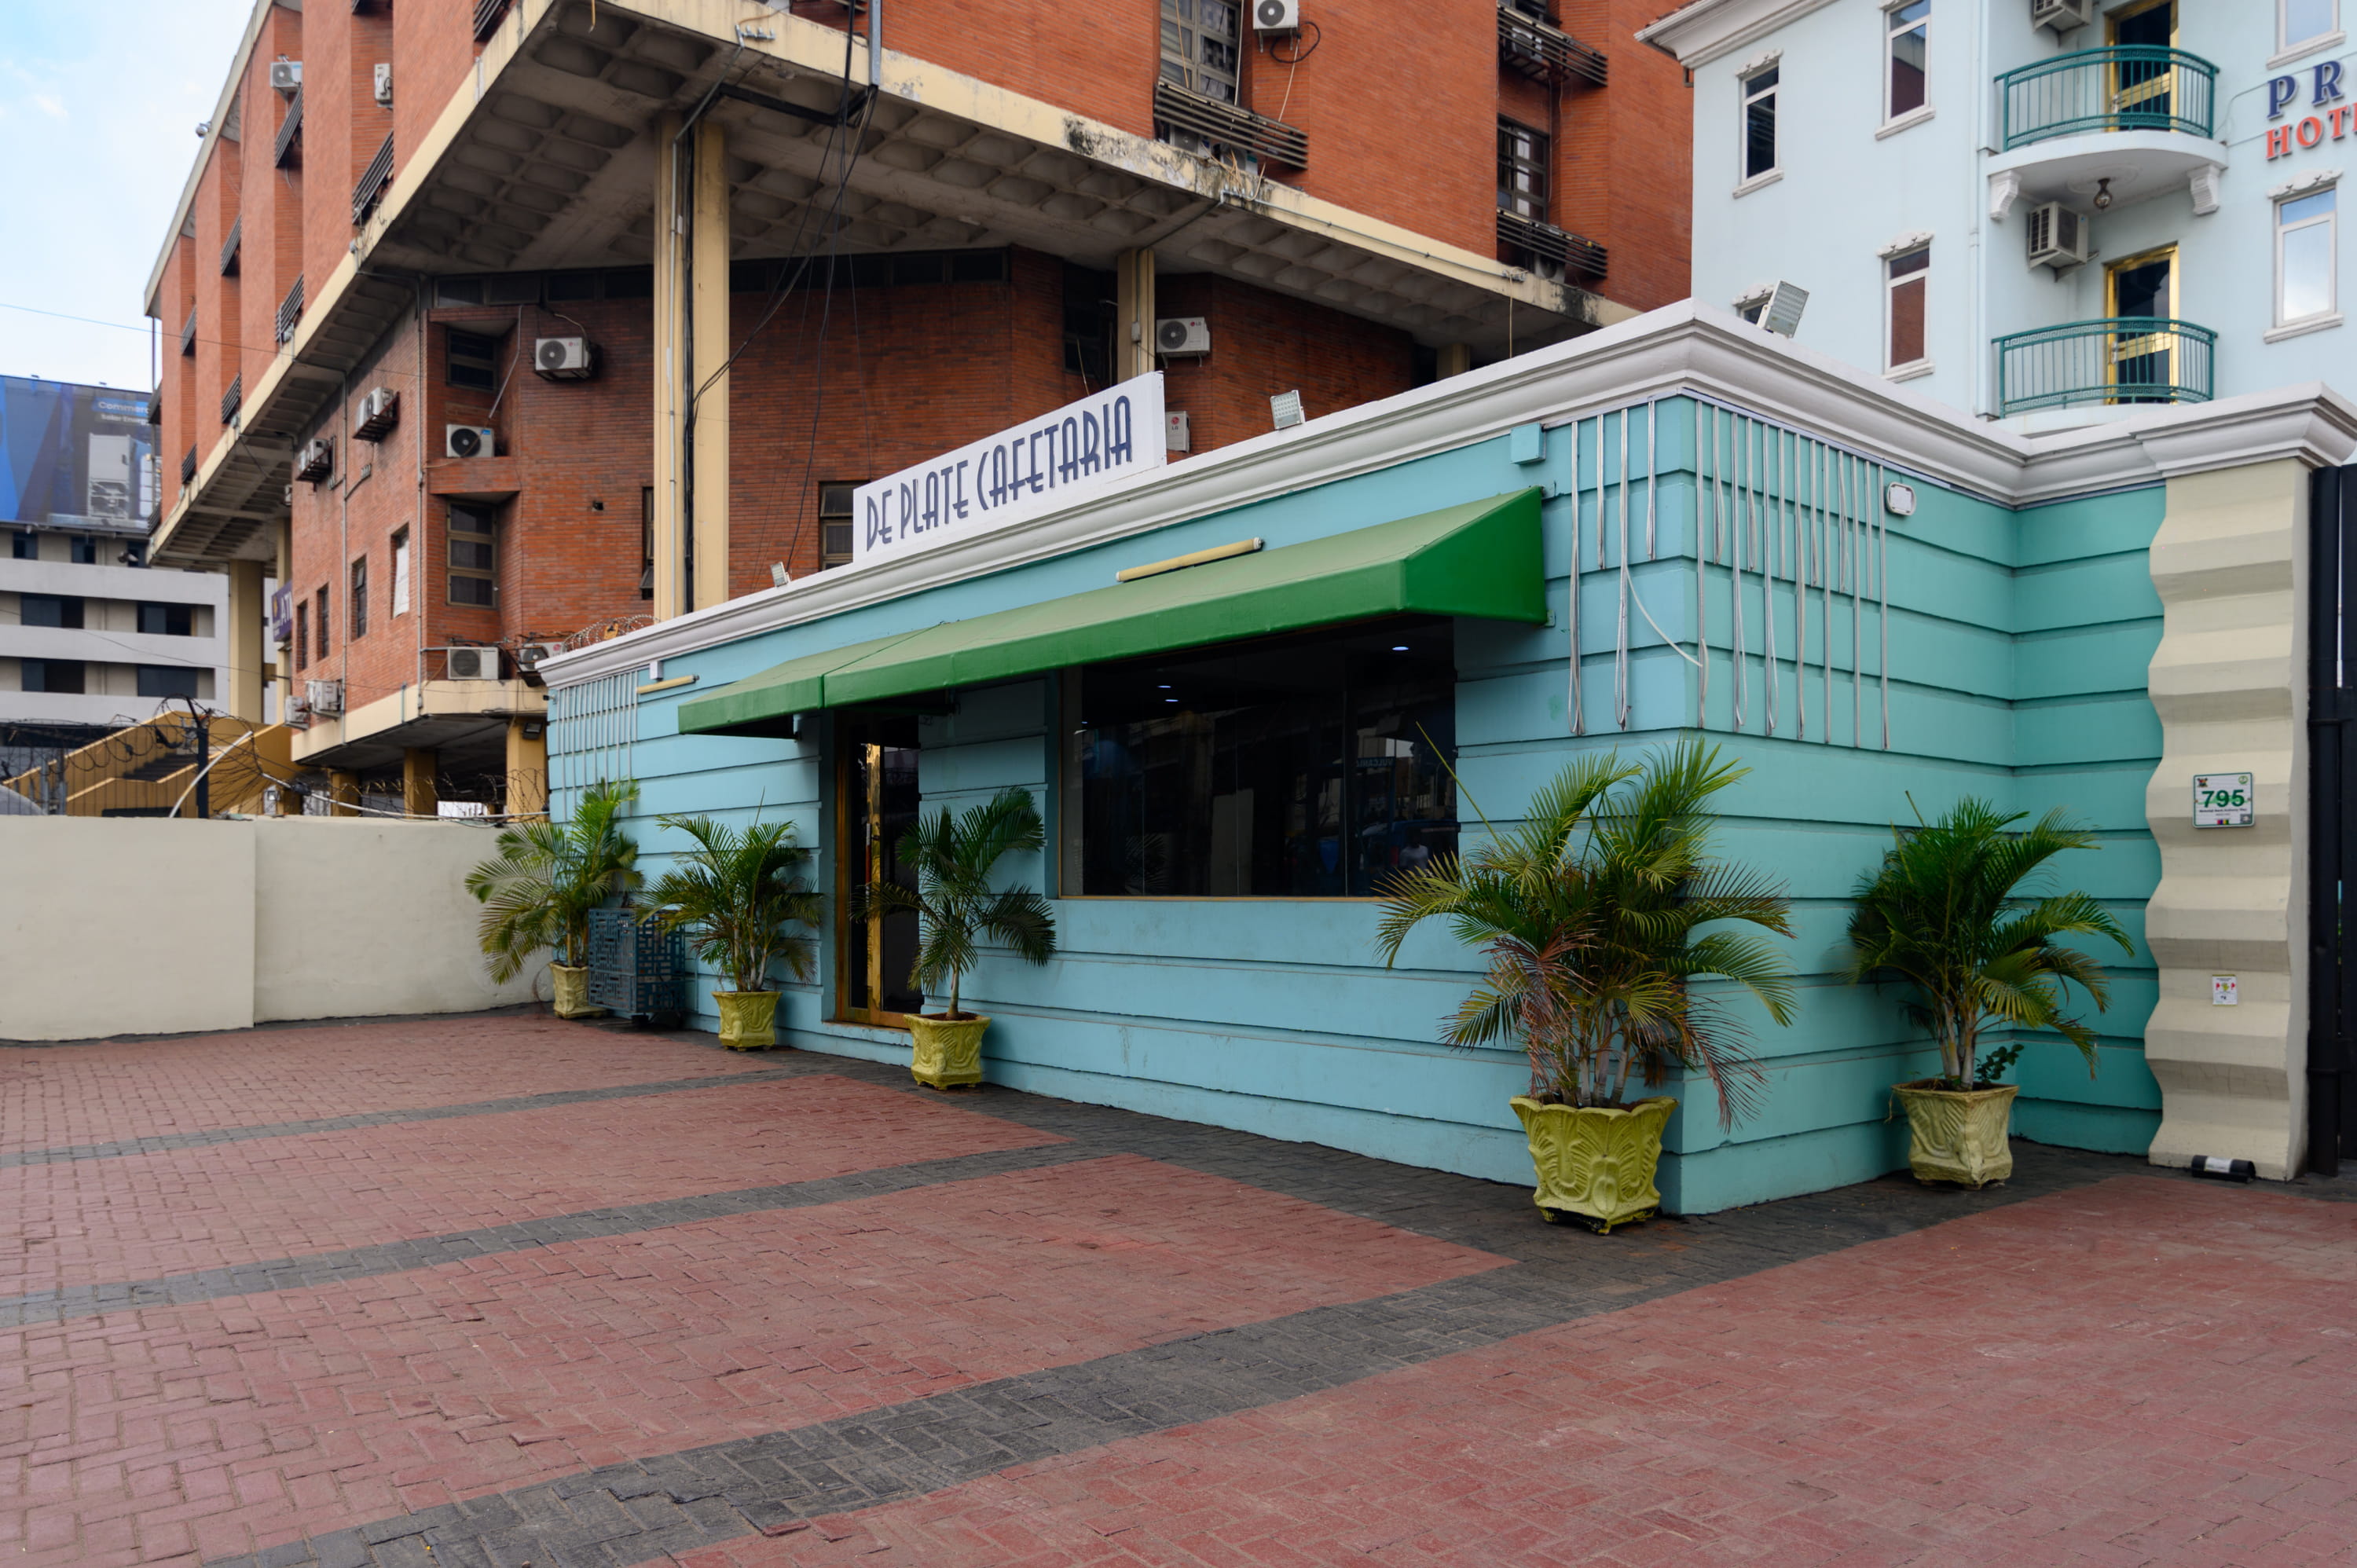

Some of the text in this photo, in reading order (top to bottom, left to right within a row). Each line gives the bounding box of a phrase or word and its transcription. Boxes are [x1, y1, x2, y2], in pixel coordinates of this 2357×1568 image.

[867, 395, 1133, 551] DE PLATE CAFETARIA
[2201, 789, 2245, 808] 795
